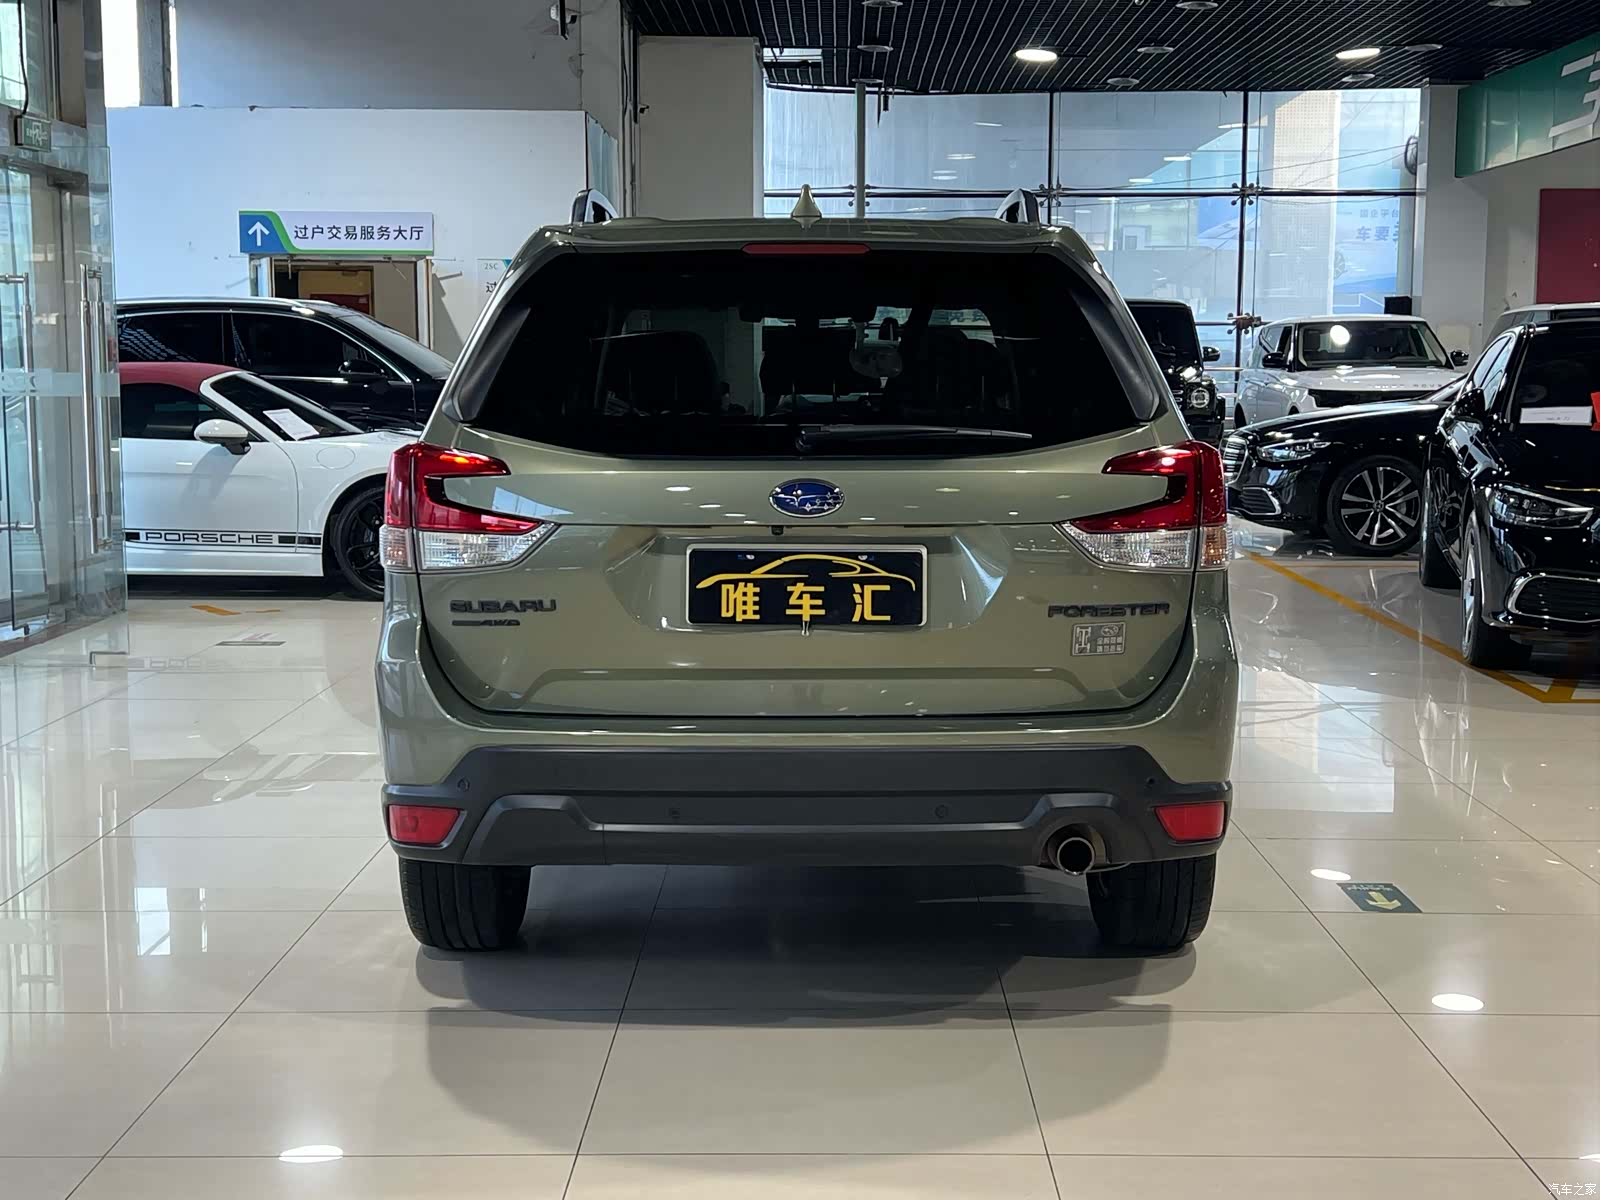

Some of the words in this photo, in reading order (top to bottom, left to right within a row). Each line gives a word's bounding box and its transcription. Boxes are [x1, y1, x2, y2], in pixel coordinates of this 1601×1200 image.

[294, 224, 425, 241] 过户交易服务大厅
[145, 531, 274, 545] PORSCHE
[449, 599, 557, 613] SUBARU
[720, 581, 892, 622] 唯车汇
[1047, 602, 1170, 618] FORESTER
